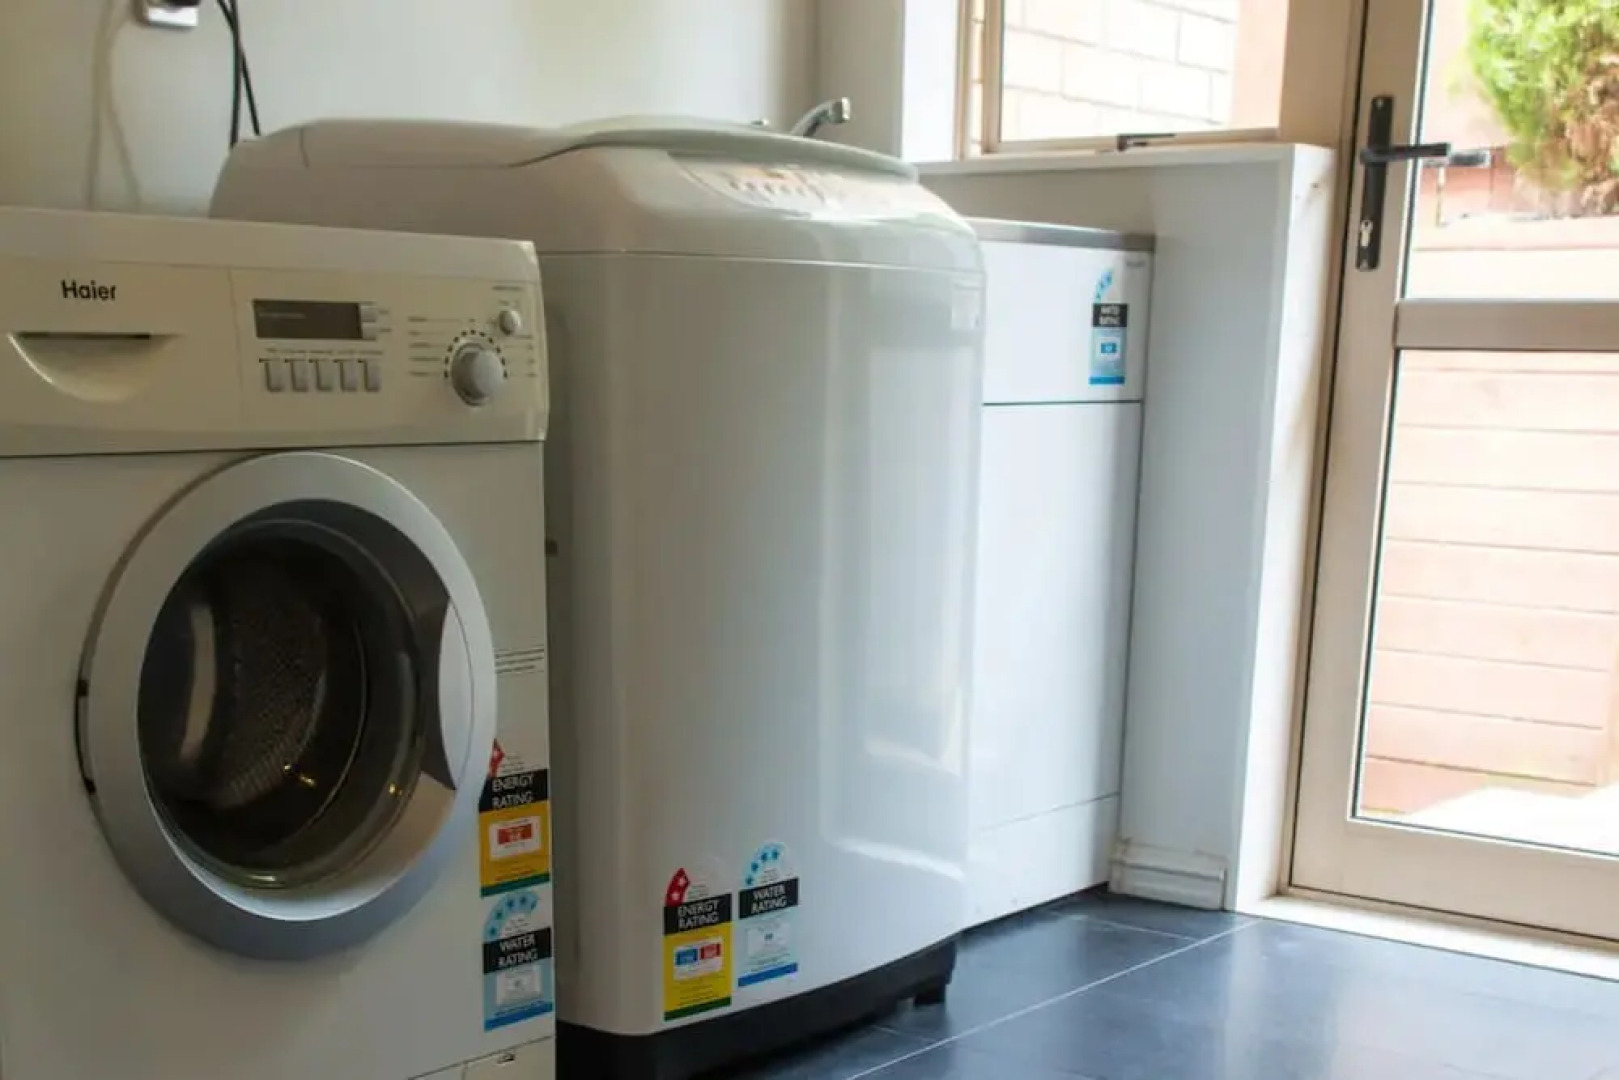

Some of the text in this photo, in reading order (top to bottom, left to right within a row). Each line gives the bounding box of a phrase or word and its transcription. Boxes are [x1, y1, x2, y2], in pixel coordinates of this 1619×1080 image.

[60, 278, 118, 302] Haier
[491, 773, 535, 793] ENERGY
[491, 790, 533, 809] RATING
[752, 884, 786, 900] WATER
[677, 899, 719, 918] ENERGY
[750, 897, 787, 914] RATING
[678, 914, 719, 929] RATING
[499, 932, 537, 953] WATER
[497, 948, 538, 968] RATING
